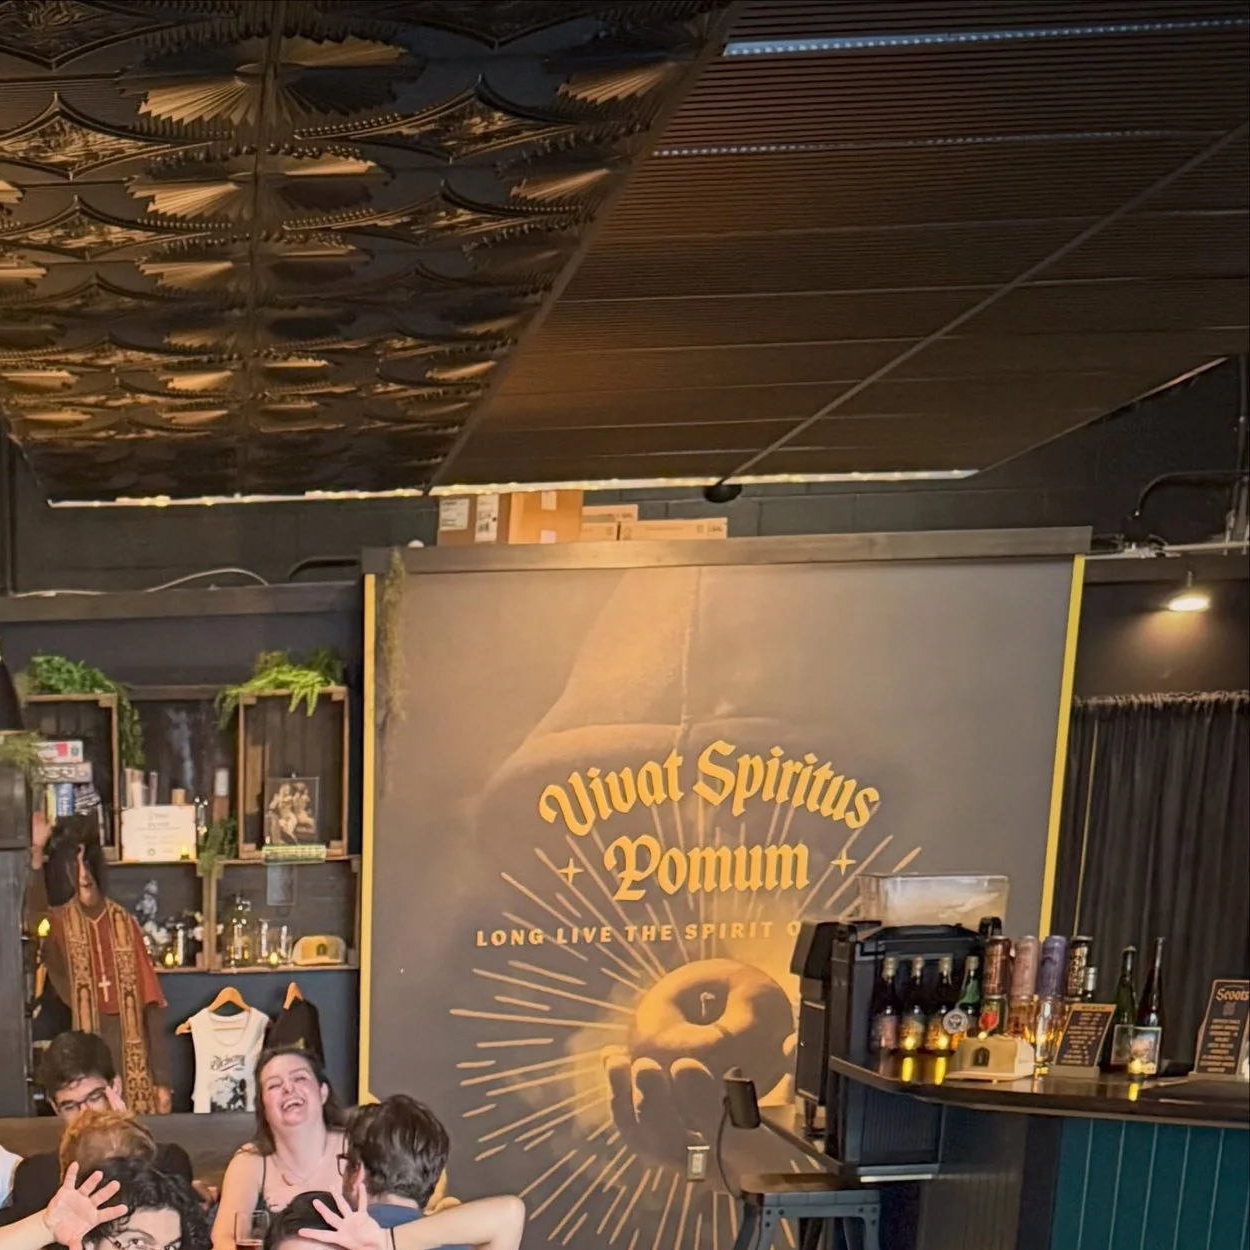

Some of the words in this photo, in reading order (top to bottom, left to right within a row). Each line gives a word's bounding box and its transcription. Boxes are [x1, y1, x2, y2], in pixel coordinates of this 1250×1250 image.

[538, 747, 685, 837] Vivat
[692, 739, 881, 830] Spiritus
[603, 834, 810, 901] Pomum
[476, 928, 544, 947] LONG
[556, 926, 612, 945] LIVE
[625, 924, 673, 942] THE
[685, 921, 773, 940] SPIRIT
